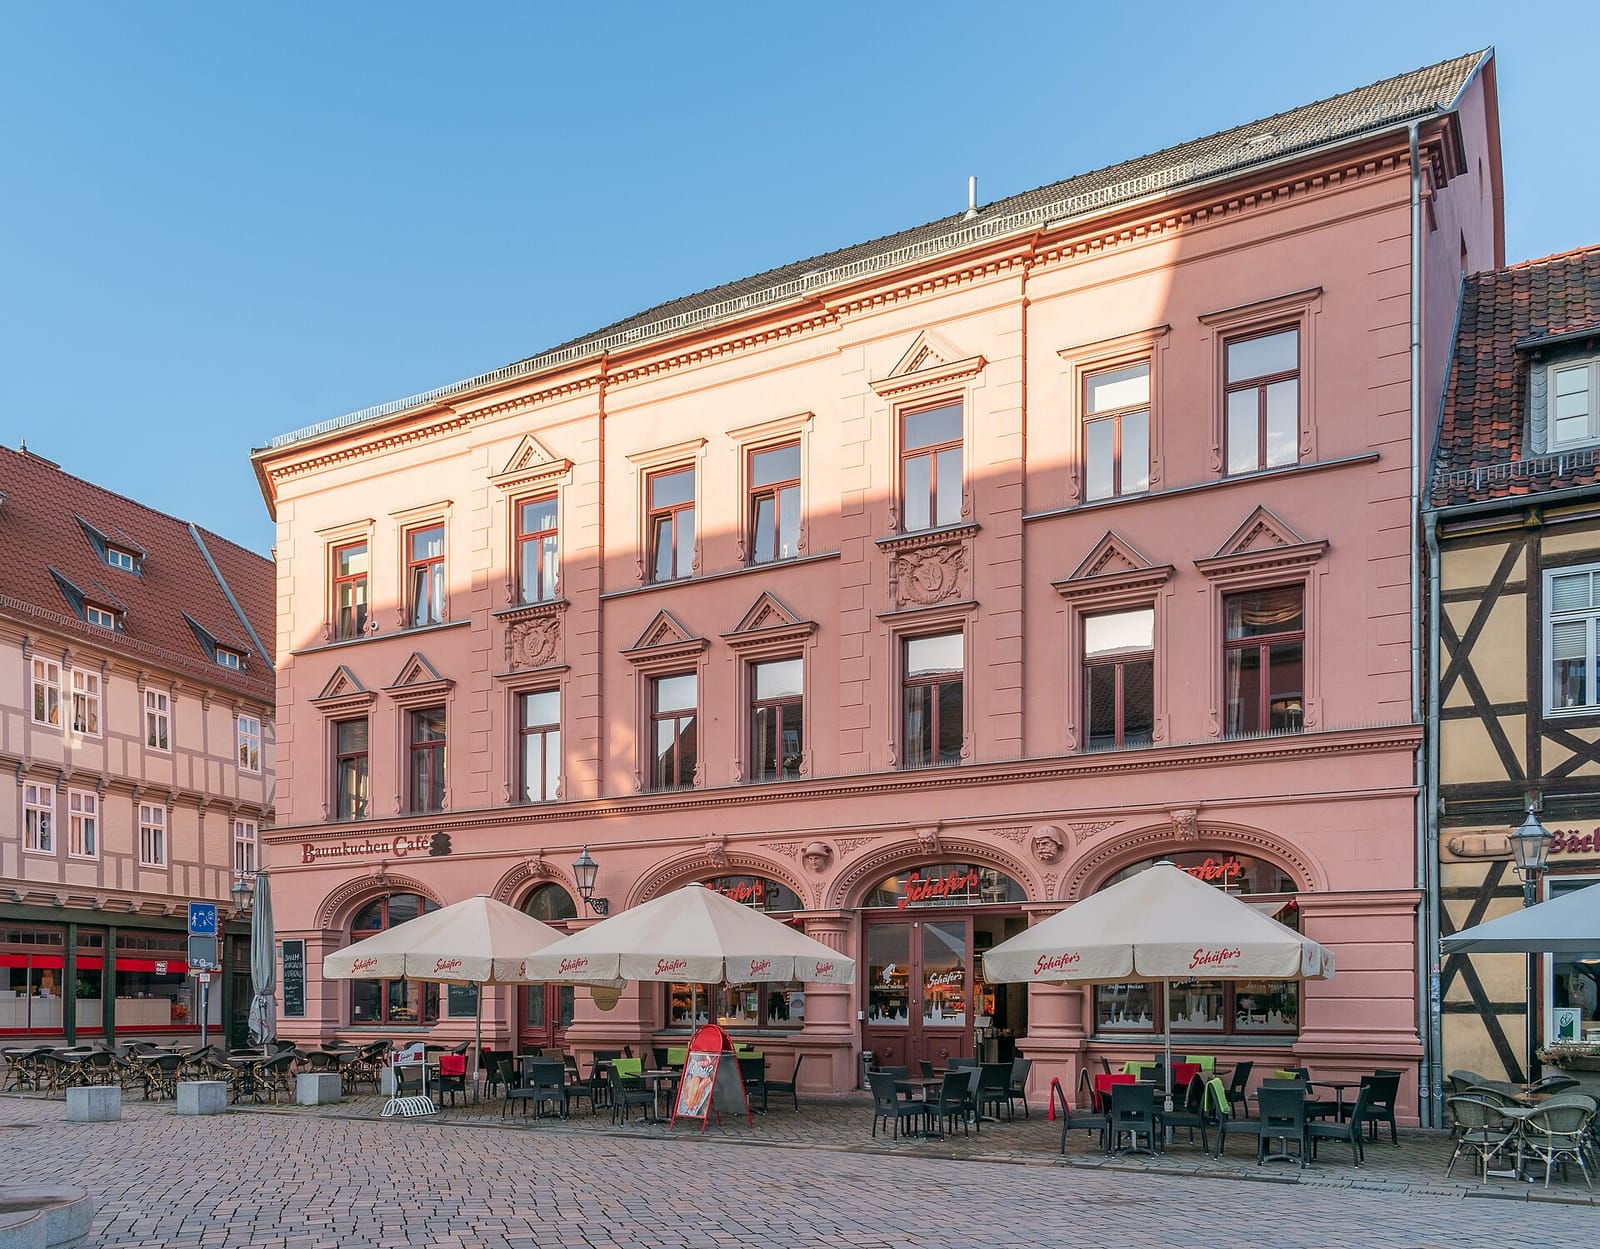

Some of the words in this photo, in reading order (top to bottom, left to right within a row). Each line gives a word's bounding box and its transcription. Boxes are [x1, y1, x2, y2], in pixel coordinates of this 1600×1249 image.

[301, 840, 390, 864] Baumkuchen
[392, 834, 430, 857] Café
[897, 871, 978, 910] Schäfer's
[352, 957, 378, 974] Schäfer's
[433, 958, 462, 974] Schäfer's
[558, 957, 588, 975] Schäfer's
[655, 958, 687, 976] Schäfer's
[1034, 951, 1080, 975] Schäfer's
[1189, 947, 1241, 970] Schäfer's
